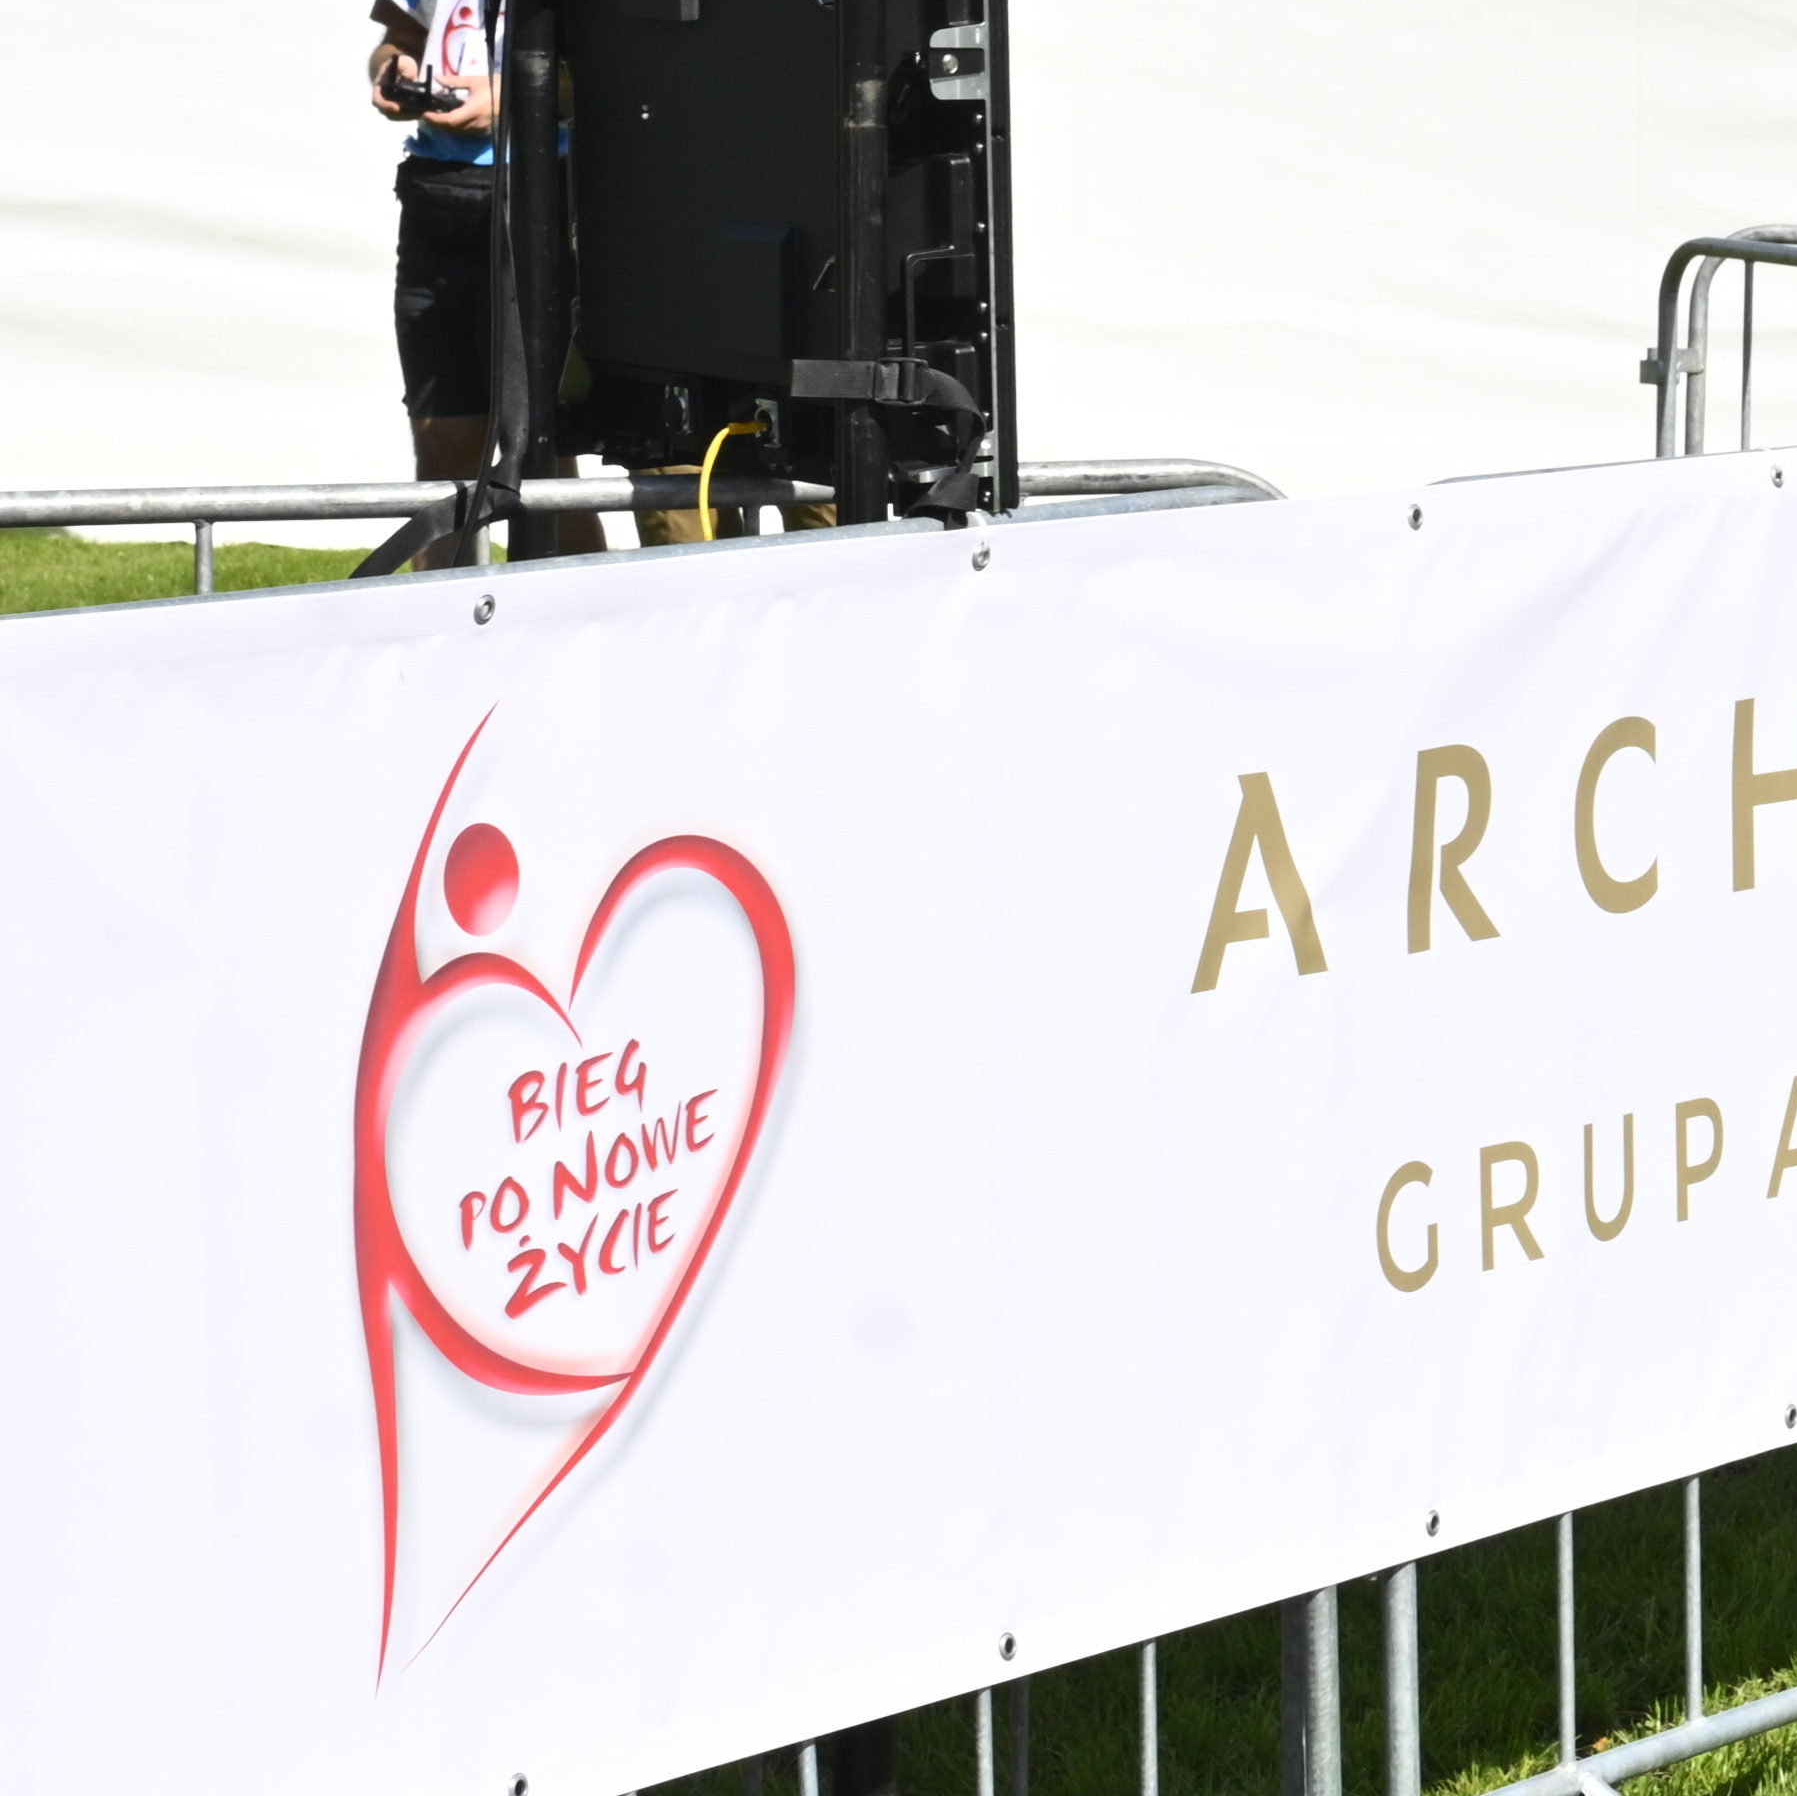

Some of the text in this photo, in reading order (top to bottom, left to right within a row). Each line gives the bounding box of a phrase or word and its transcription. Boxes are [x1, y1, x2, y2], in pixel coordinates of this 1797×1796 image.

[507, 1038, 647, 1144] BIEG
[459, 1088, 719, 1250] PO NOWE
[505, 1188, 679, 1319] ŻYCIE
